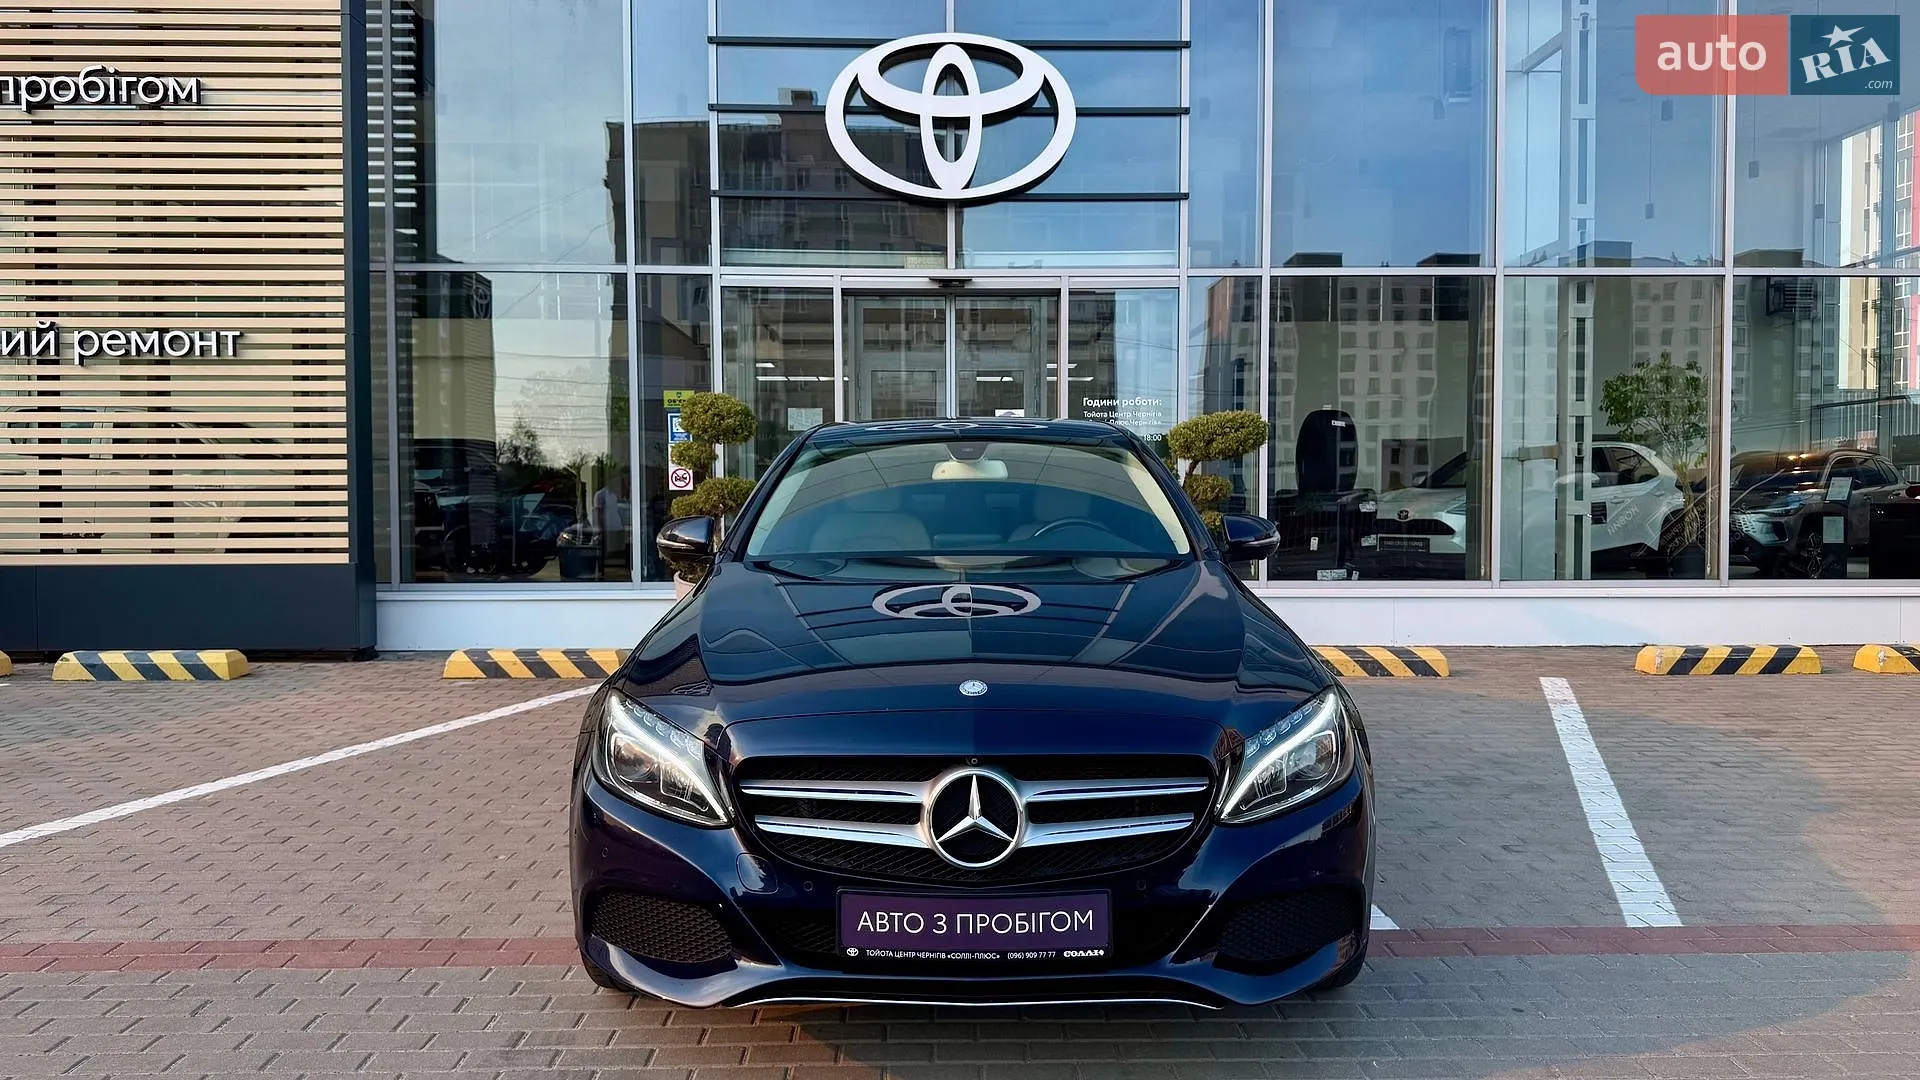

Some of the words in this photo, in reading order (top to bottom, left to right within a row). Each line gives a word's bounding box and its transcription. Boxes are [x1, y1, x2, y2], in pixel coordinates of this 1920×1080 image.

[73, 329, 241, 366] ремонт
[1083, 398, 1119, 407] Години
[1122, 397, 1162, 407] роботи:
[1083, 410, 1108, 418] Тойота
[1109, 410, 1132, 419] Центр
[856, 910, 925, 935] АВТО
[932, 913, 948, 935] З
[956, 909, 1094, 935] ПРОБІГОМ
[866, 949, 894, 957] ТОЙОТА
[894, 950, 917, 958] ЦЕНТР
[917, 951, 946, 959] ЧЕРНІГІВ
[1007, 951, 1025, 960] (096)
[1025, 951, 1038, 959] 909
[1038, 951, 1047, 959] 77
[1047, 951, 1056, 959] 77
